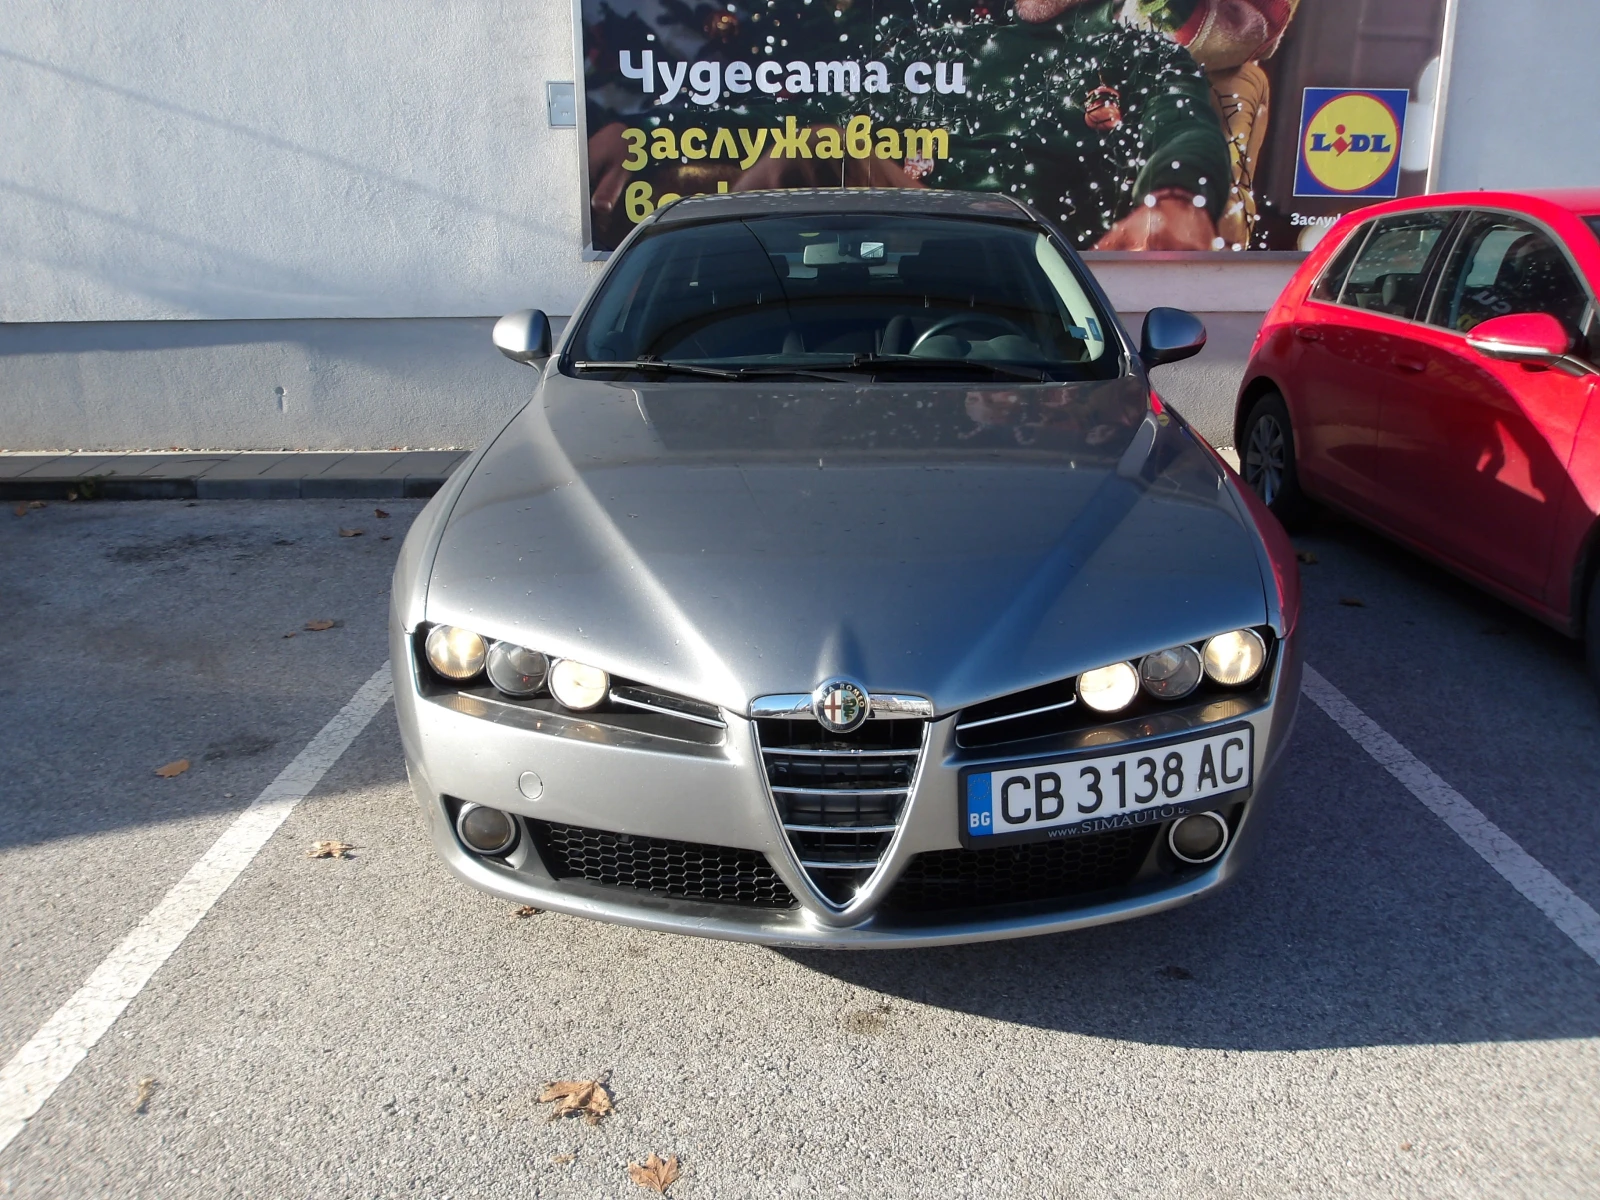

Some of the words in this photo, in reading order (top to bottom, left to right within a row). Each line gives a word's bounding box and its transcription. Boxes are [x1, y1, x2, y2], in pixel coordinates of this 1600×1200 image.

[619, 50, 890, 105] Чудесата
[904, 62, 966, 94] си
[621, 115, 949, 171] заслужават
[840, 683, 865, 708] ROMEO
[1077, 752, 1184, 813] 3138
[970, 811, 991, 828] BG
